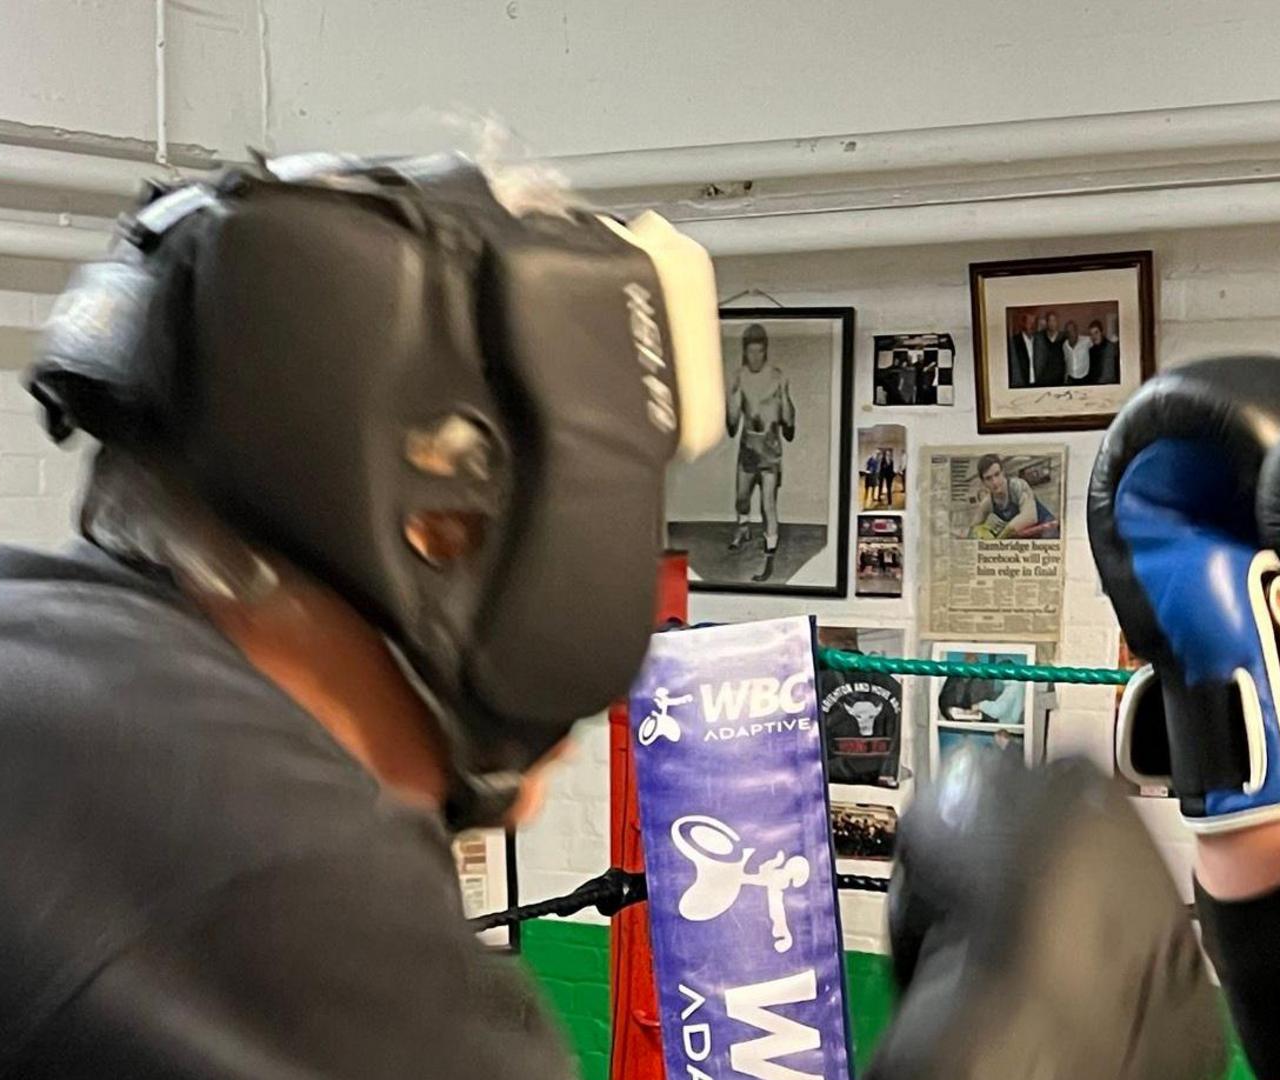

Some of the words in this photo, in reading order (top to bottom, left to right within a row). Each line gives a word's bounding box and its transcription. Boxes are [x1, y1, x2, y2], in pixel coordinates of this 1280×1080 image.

[977, 553, 1021, 563] Facebook
[977, 566, 995, 576] him
[998, 565, 1021, 578] edge
[1022, 567, 1033, 576] in
[699, 672, 809, 723] WBC
[704, 717, 811, 742] ADAPTIVE
